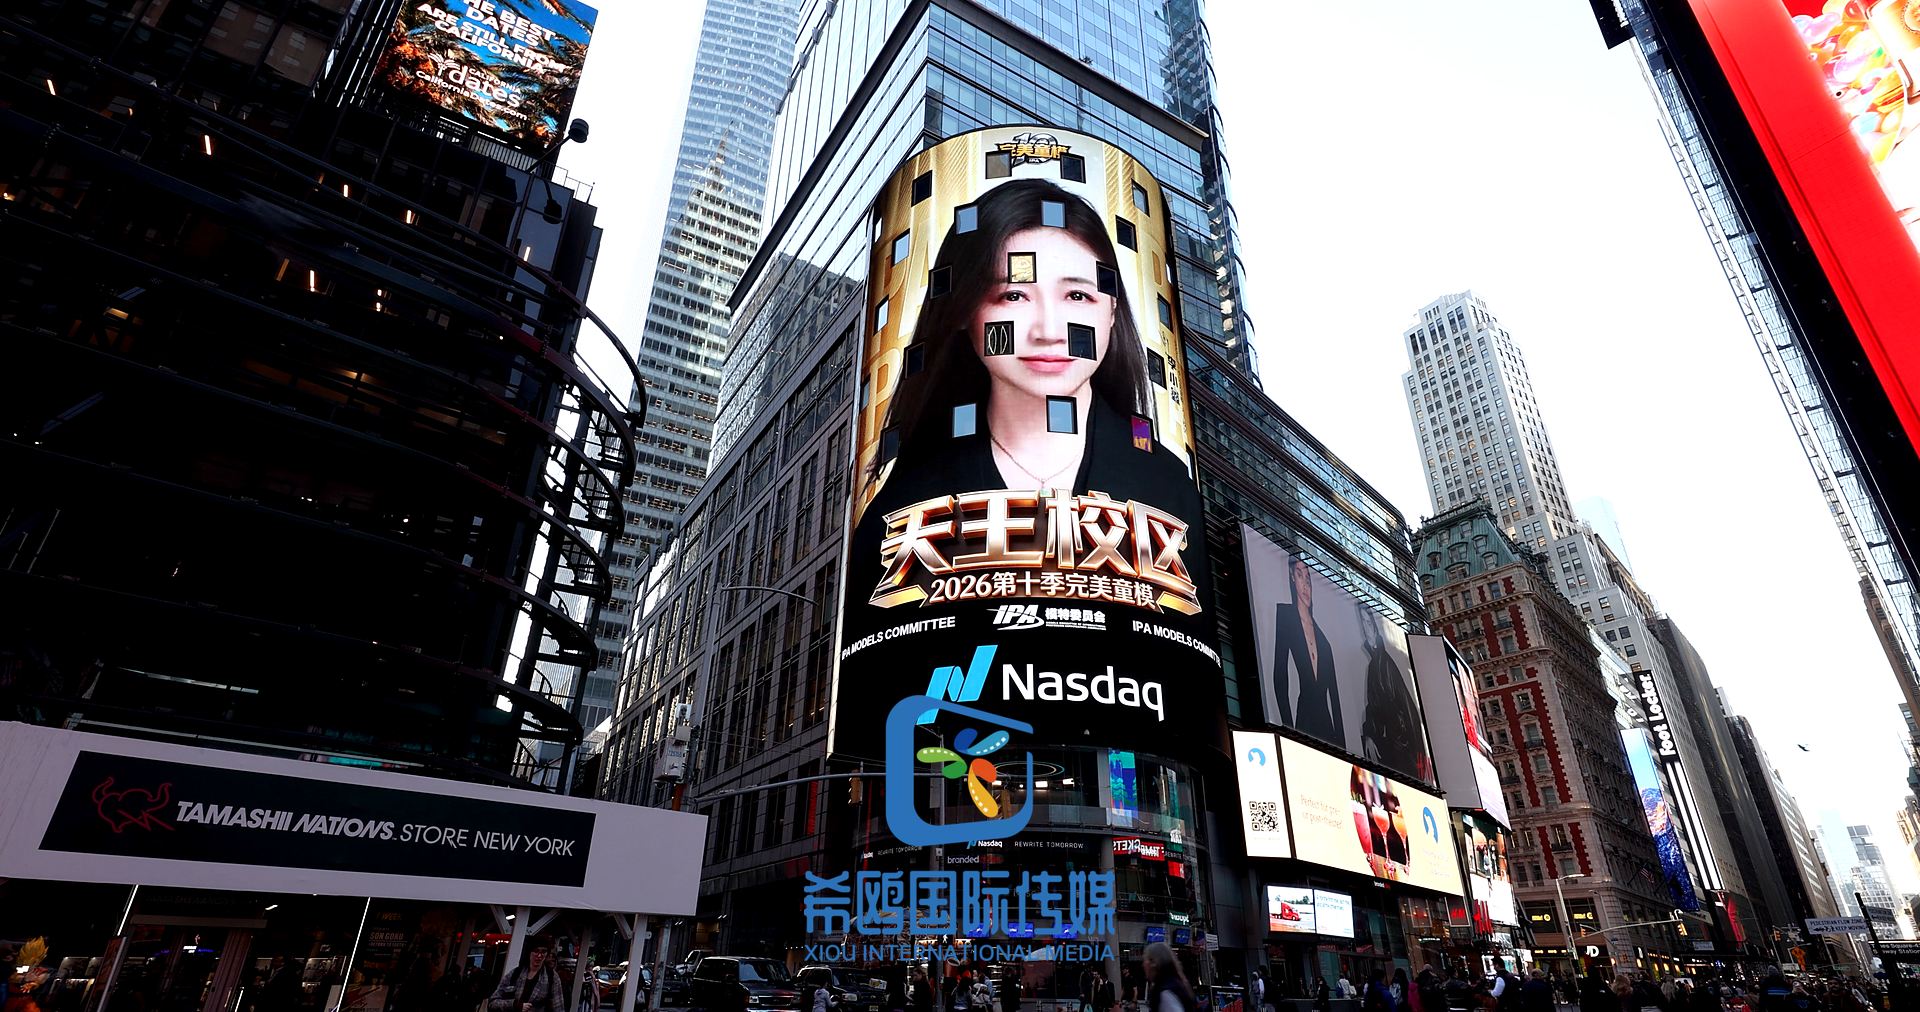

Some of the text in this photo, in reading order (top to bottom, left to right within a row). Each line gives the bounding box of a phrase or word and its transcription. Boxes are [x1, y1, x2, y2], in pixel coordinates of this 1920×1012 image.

[417, 3, 459, 27] ARE
[461, 21, 510, 48] STILL
[463, 0, 556, 41] HE BEST
[466, 6, 539, 47] DATES
[434, 20, 549, 76] CALIFORNIA
[449, 65, 521, 108] dates
[869, 488, 1202, 614] 天王校区
[930, 570, 1156, 610] 2026第十季完美童模
[851, 631, 884, 655] MODELS
[884, 615, 956, 641] COMMITTEE
[991, 603, 1041, 626] IPA
[1132, 619, 1152, 635] IPA
[1153, 625, 1193, 648] MODELS
[1001, 662, 1165, 722] Nasdaq
[1638, 673, 1677, 756] Foot Locker
[176, 800, 576, 857] TAMASHII NATIONS STORE NEW YORK
[978, 839, 1003, 849] Nasdaq
[1046, 842, 1084, 850] TOMORROW
[947, 854, 980, 864] branded
